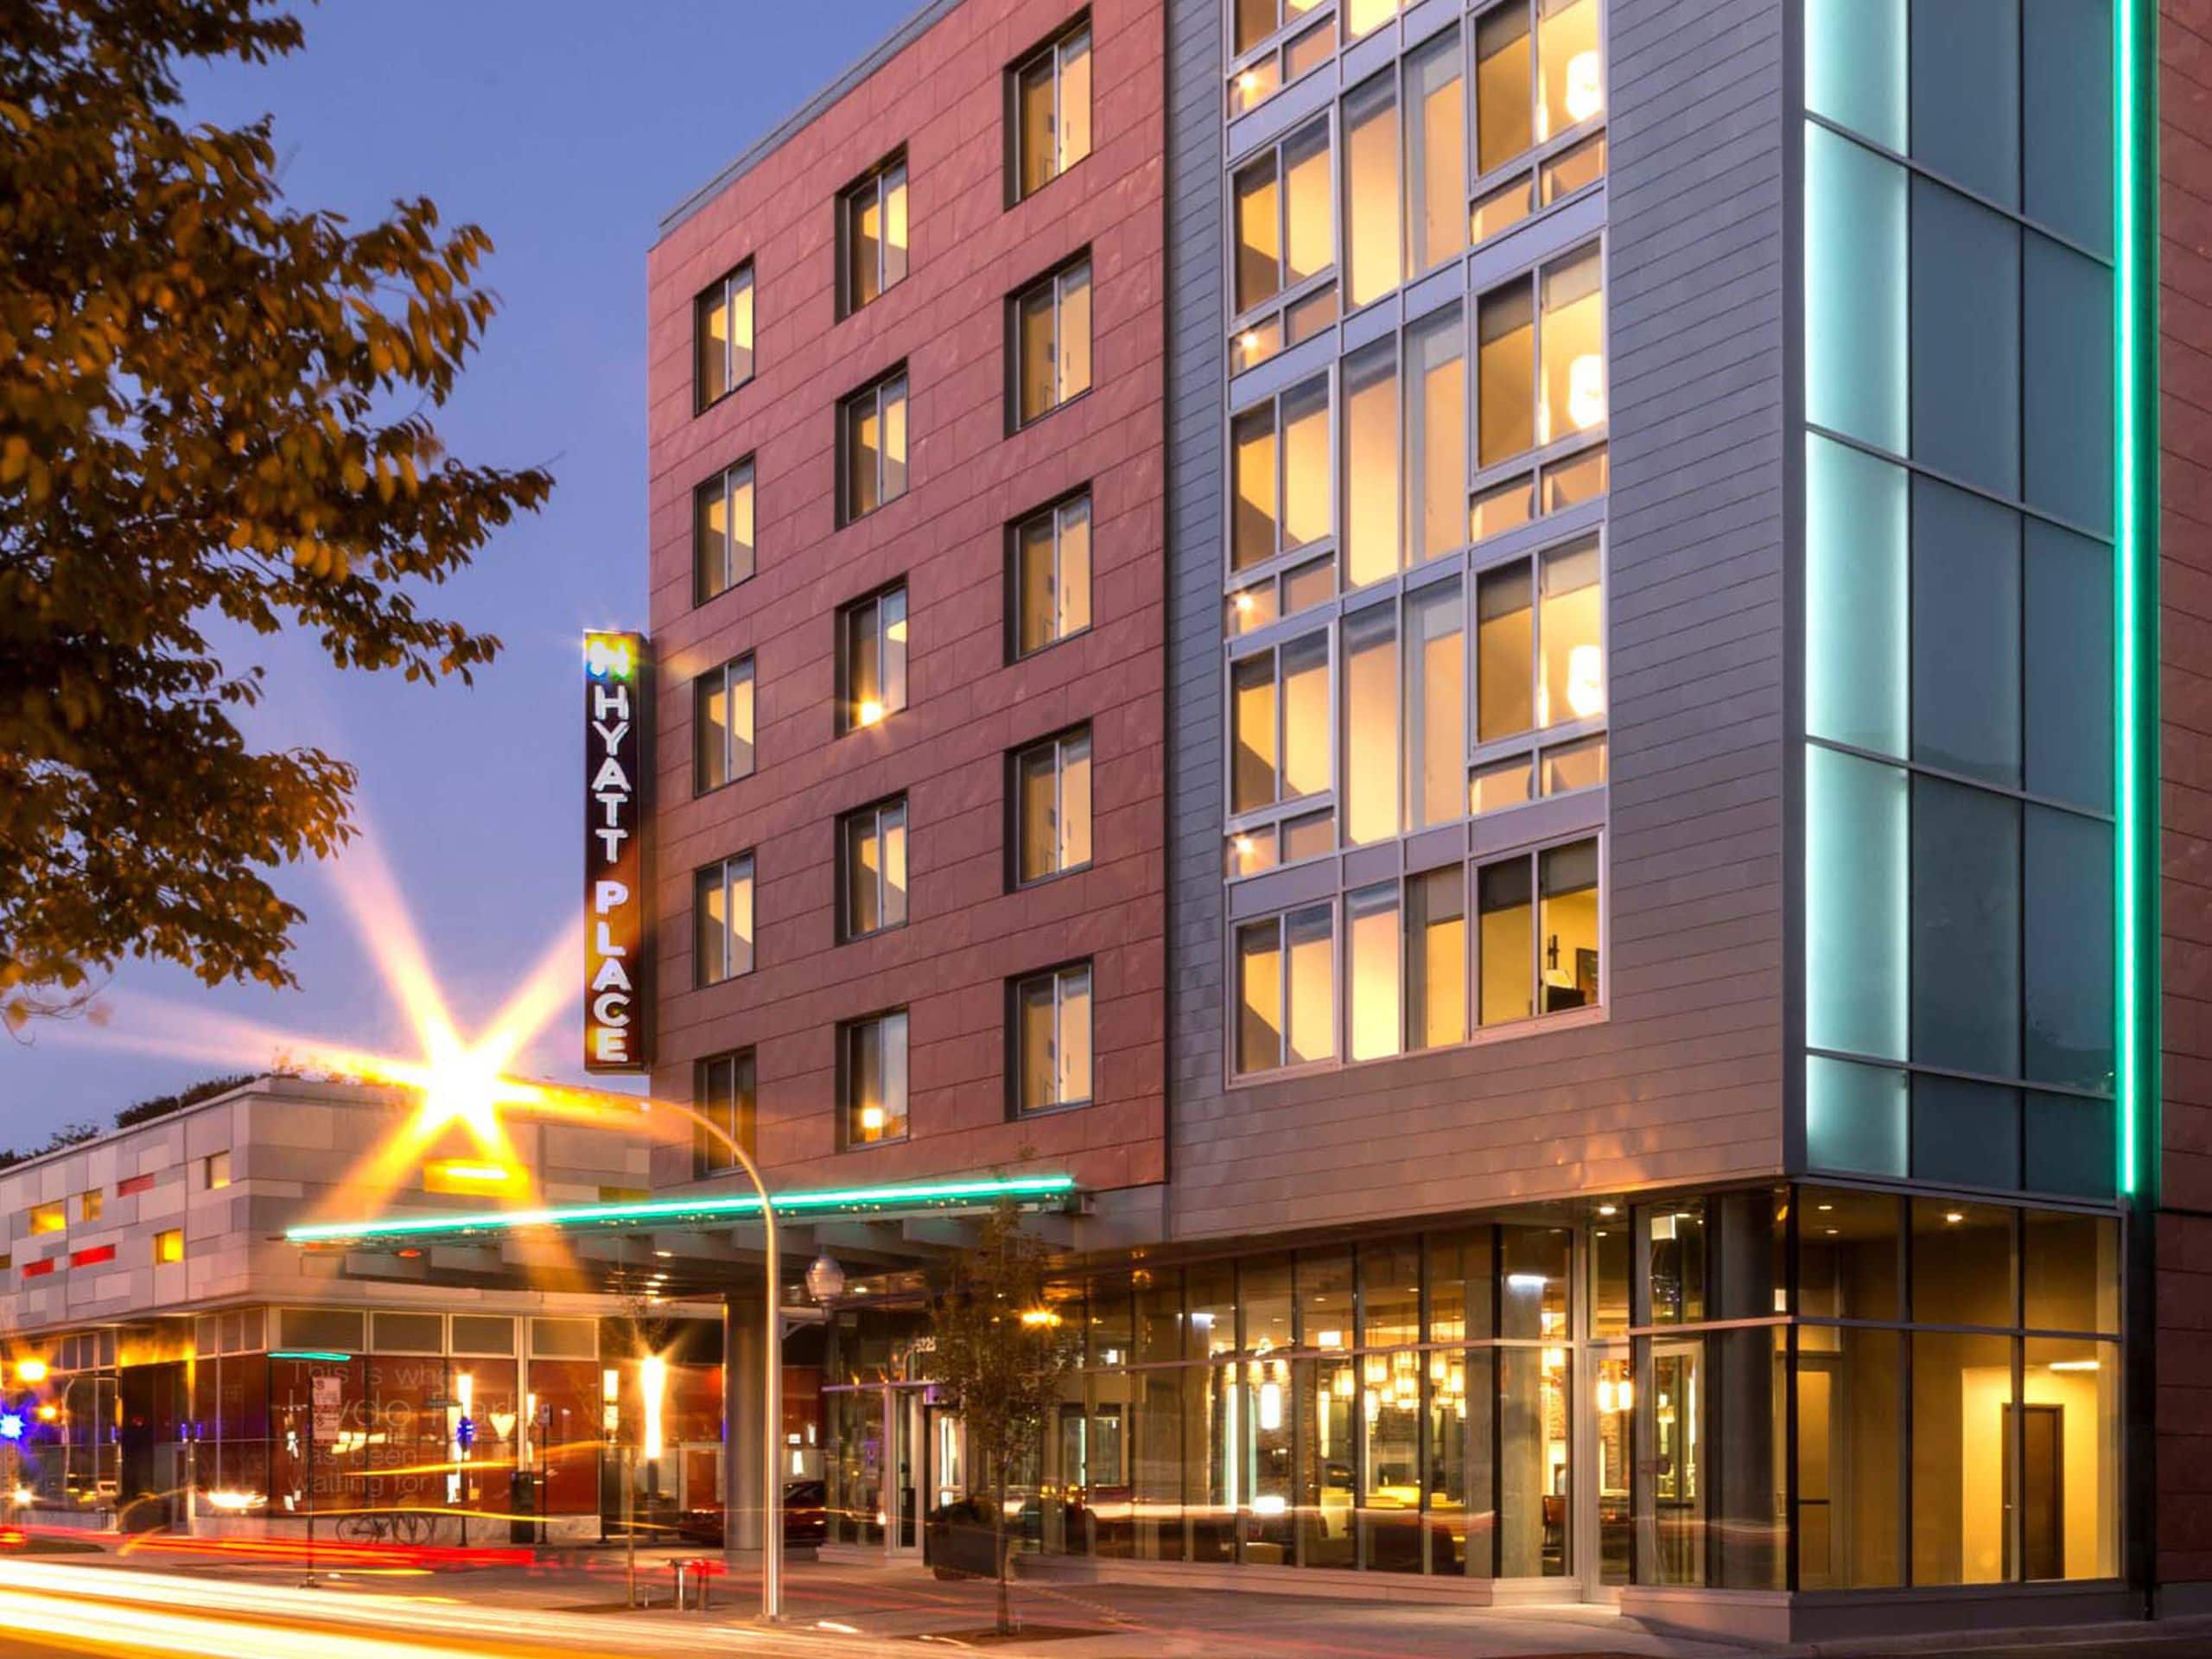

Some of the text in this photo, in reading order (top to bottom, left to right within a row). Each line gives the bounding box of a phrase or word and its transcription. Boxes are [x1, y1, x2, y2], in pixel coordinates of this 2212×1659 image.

[592, 684, 632, 1063] HYATT PLACE
[288, 1360, 349, 1384] This
